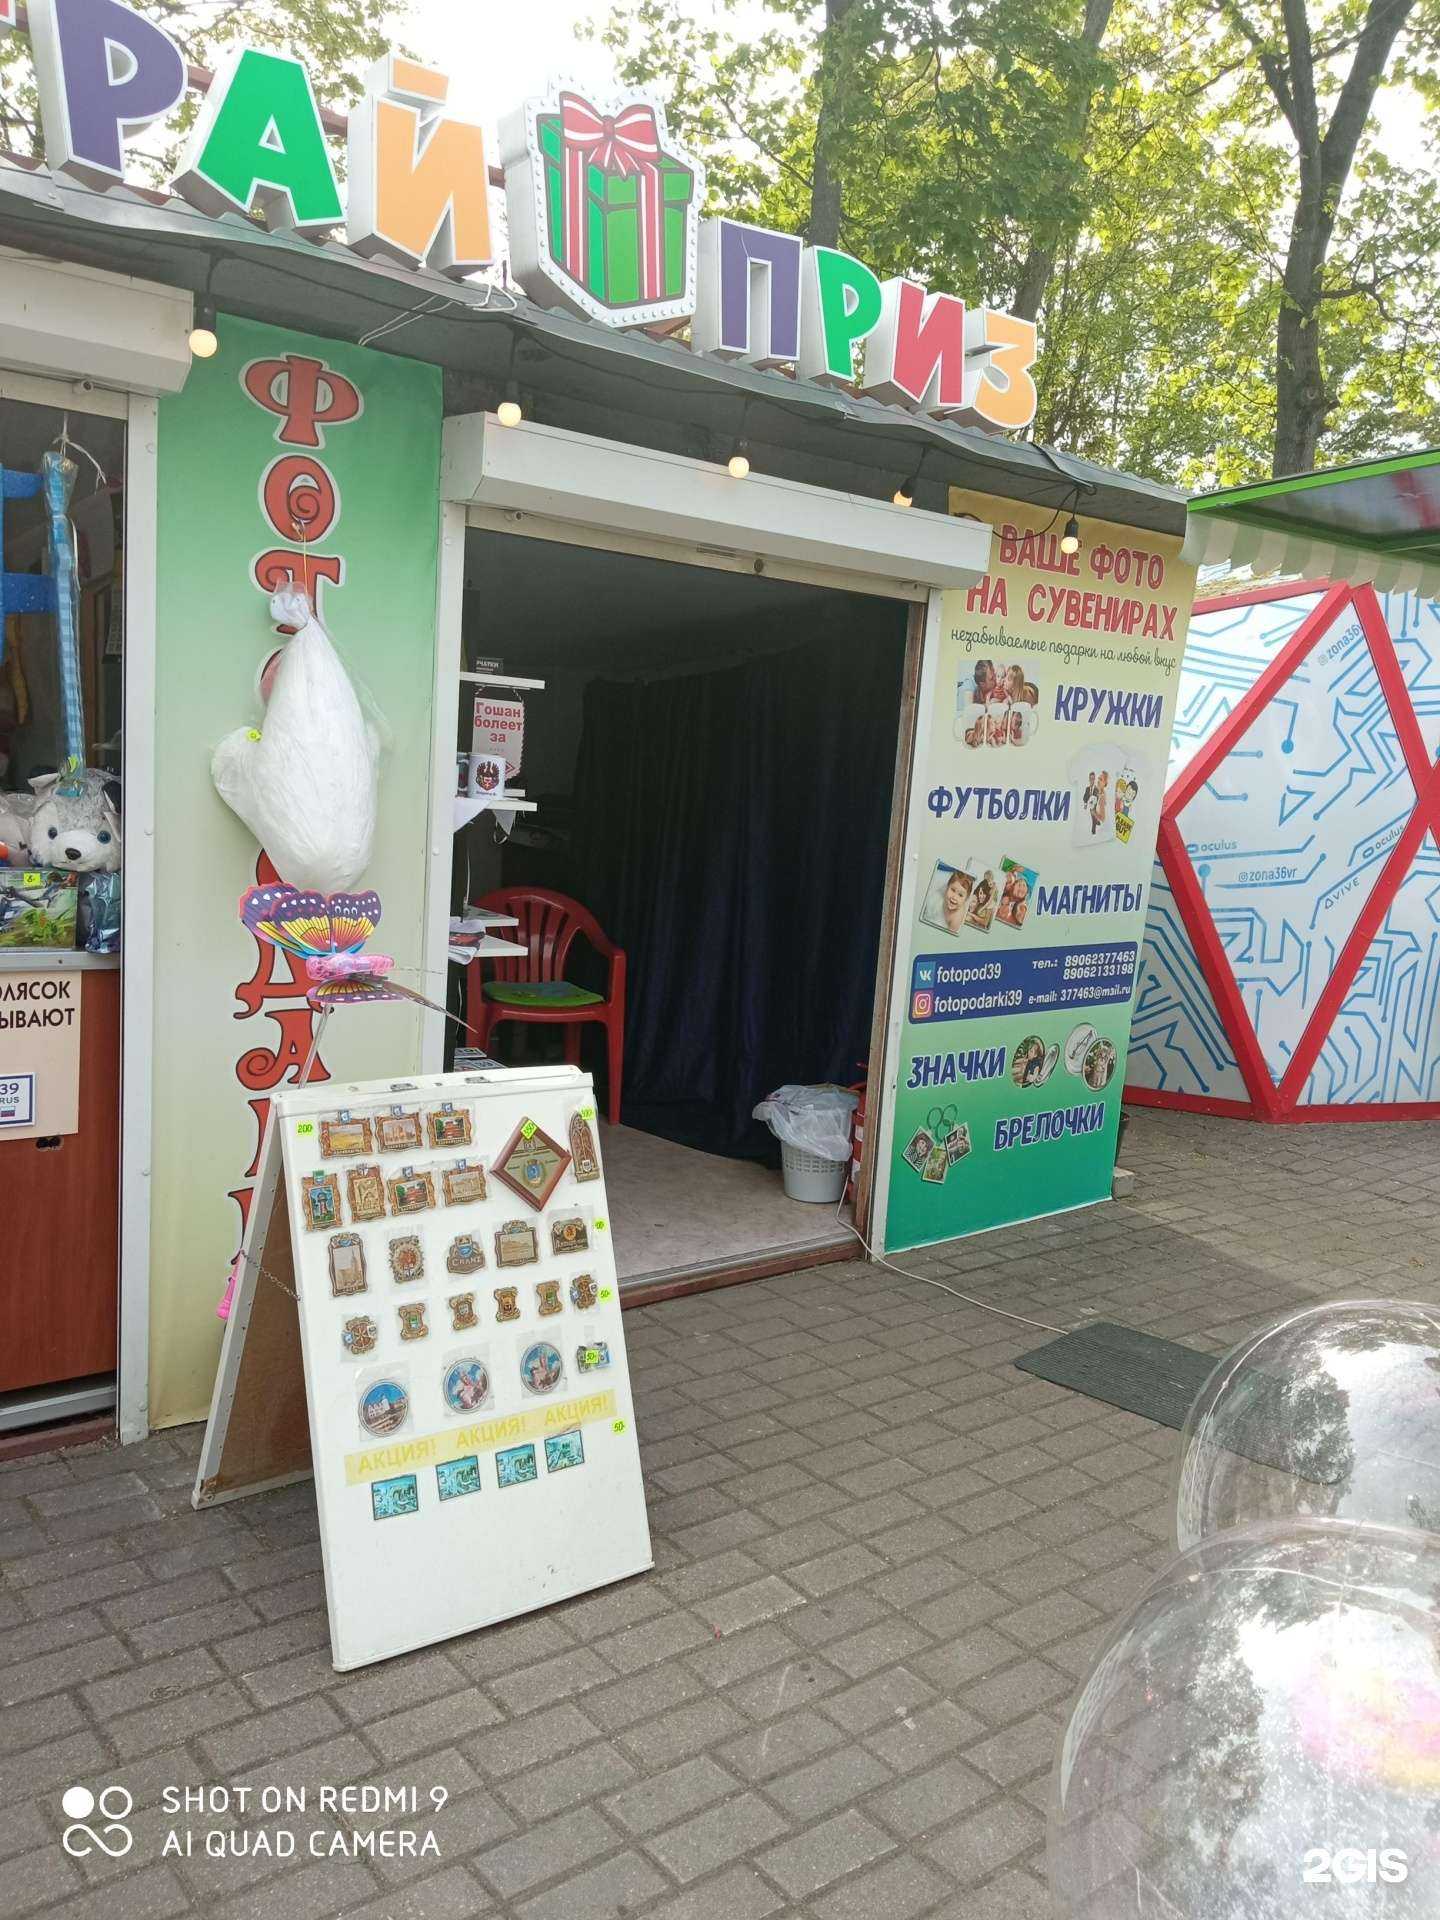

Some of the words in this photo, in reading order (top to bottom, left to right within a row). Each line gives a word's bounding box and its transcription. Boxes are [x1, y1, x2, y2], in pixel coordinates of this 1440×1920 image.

[0, 0, 494, 270] РАЙ
[714, 217, 1038, 430] ПРИЗ
[1090, 544, 1165, 590] ФОТО
[966, 575, 1008, 617] НА
[1027, 583, 1178, 641] СУВЕНИРАХ
[951, 625, 1047, 652] незабываемые
[1048, 642, 1099, 665] подарки
[1100, 648, 1115, 661] на
[1114, 647, 1153, 665] любой
[1153, 651, 1177, 676] вкус
[475, 702, 521, 718] Гошан
[1054, 684, 1164, 729] КРУЖКИ
[474, 715, 522, 731] болеет
[489, 732, 506, 743] за
[927, 785, 1072, 821] ФУТБОЛКИ
[1200, 840, 1238, 852] oculus
[1036, 883, 1143, 917] МАГНИТЫ
[1332, 877, 1360, 901] VIVE
[937, 963, 1002, 985] fotopod39
[1032, 959, 1058, 970] тел.:
[1065, 950, 1136, 967] 89062377463
[1063, 963, 1134, 980] 89062133198
[0, 981, 70, 1001] ЛЯСОК
[934, 990, 1023, 1015] fotopodarki39
[1028, 991, 1057, 1005] e-mail:
[1060, 984, 1131, 1001] 377463@mail.ru
[906, 1046, 1007, 1089] ЗНАЧКИ
[993, 1102, 1105, 1150] БРЕЛОЧКИ
[358, 1440, 437, 1474] АКЦИЯ!
[456, 1416, 526, 1449] АКЦИЯ!
[544, 1395, 609, 1427] АКЦИЯ!
